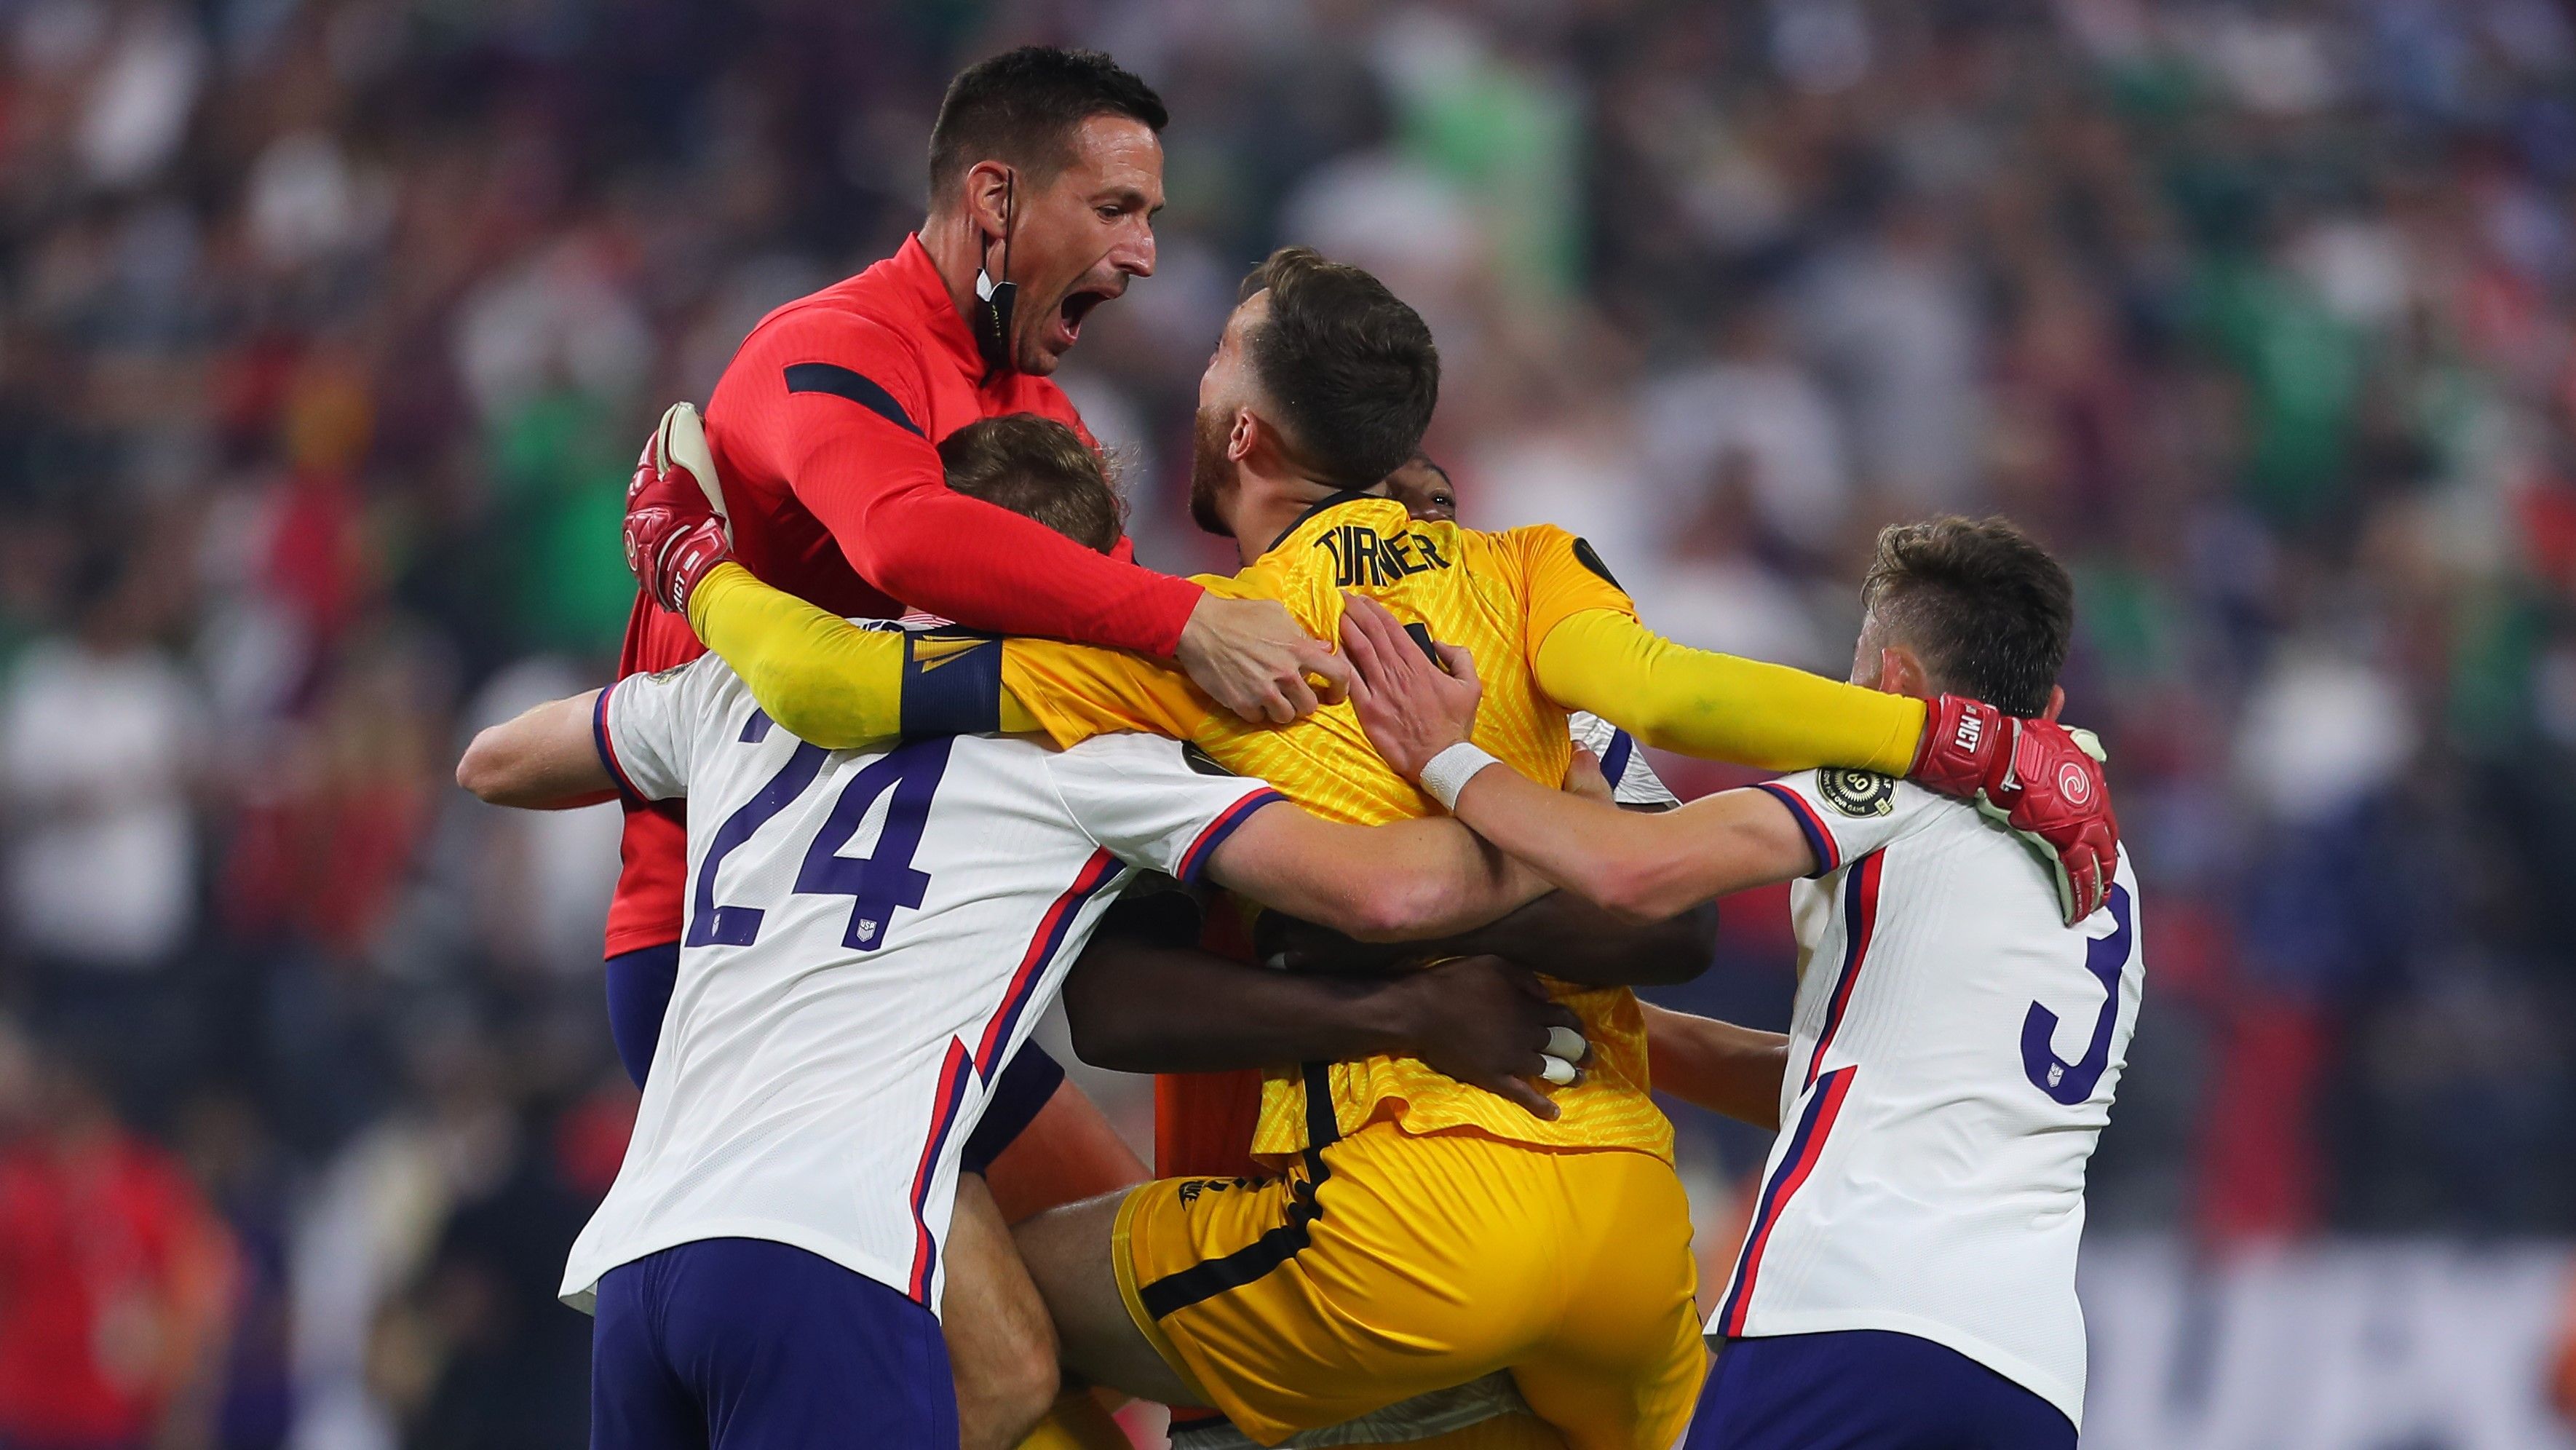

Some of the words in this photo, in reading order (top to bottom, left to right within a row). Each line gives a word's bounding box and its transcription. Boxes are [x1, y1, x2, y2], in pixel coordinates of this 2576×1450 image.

[1313, 526, 1451, 587] TURNER
[1955, 714, 1981, 753] MCT
[684, 706, 956, 952] 24
[2020, 881, 2132, 1106] 3
